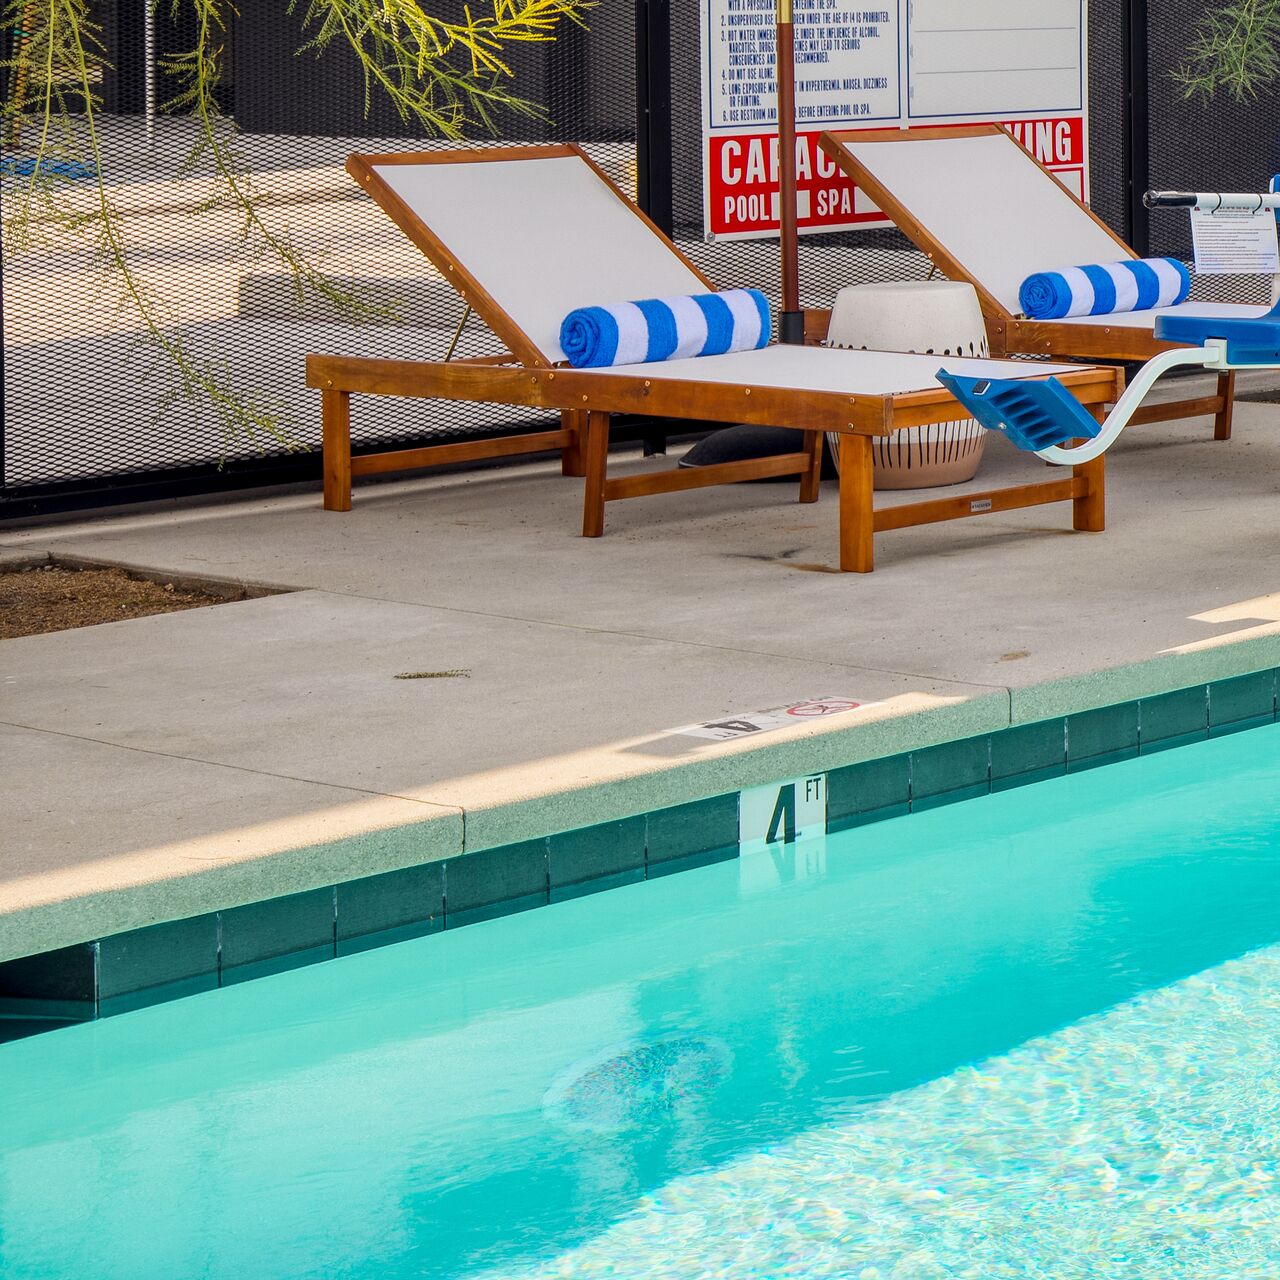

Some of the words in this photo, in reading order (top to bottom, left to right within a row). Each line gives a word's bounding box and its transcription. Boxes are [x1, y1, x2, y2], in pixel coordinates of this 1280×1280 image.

[728, 0, 740, 11] WITH
[742, 0, 745, 10] A
[747, 0, 772, 10] PHYSICIAN
[816, 0, 825, 9] THE
[721, 15, 726, 26] 2.
[728, 14, 763, 26] UNSUPERVISED
[765, 14, 773, 25] USE
[806, 13, 820, 24] UNDER
[823, 13, 831, 23] THE
[833, 13, 841, 23] AGE
[843, 12, 849, 23] OF
[850, 12, 854, 23] 14
[856, 12, 861, 23] IS
[721, 31, 726, 41] 3.
[728, 30, 737, 41] HOT
[739, 30, 755, 41] WATER
[757, 30, 775, 40] IMMERS
[801, 28, 814, 39] UNDER
[817, 28, 825, 39] THE
[827, 27, 850, 38] INFLUENCE
[852, 27, 857, 37] OF
[759, 41, 774, 52] DRUGS
[794, 41, 808, 51] CINES
[809, 40, 819, 51] MAY
[821, 40, 832, 51] LEAD
[834, 40, 840, 50] TO
[841, 39, 860, 50] SERIOUS
[729, 54, 765, 65] CONSEQUENCES
[767, 54, 776, 64] AND
[722, 70, 727, 80] 4.
[729, 69, 735, 80] DO
[737, 69, 746, 80] NOT
[748, 68, 756, 79] USE
[722, 84, 727, 95] 5.
[729, 83, 741, 95] LONG
[743, 82, 766, 94] EXPOSURE
[768, 82, 778, 93] MAY
[799, 81, 804, 92] IN
[863, 77, 887, 89] DIZZINESS
[730, 96, 735, 107] OR
[723, 110, 728, 122] 6.
[730, 110, 739, 121] USE
[741, 109, 765, 120] RESTROOM
[768, 108, 776, 119] AND
[798, 105, 815, 117] BEFORE
[817, 105, 839, 117] ENTERING
[840, 104, 851, 116] POOL
[853, 104, 859, 115] OR
[725, 194, 770, 224] POOL
[817, 187, 852, 217] SPA
[765, 783, 802, 845] 4
[805, 777, 822, 803] FT
